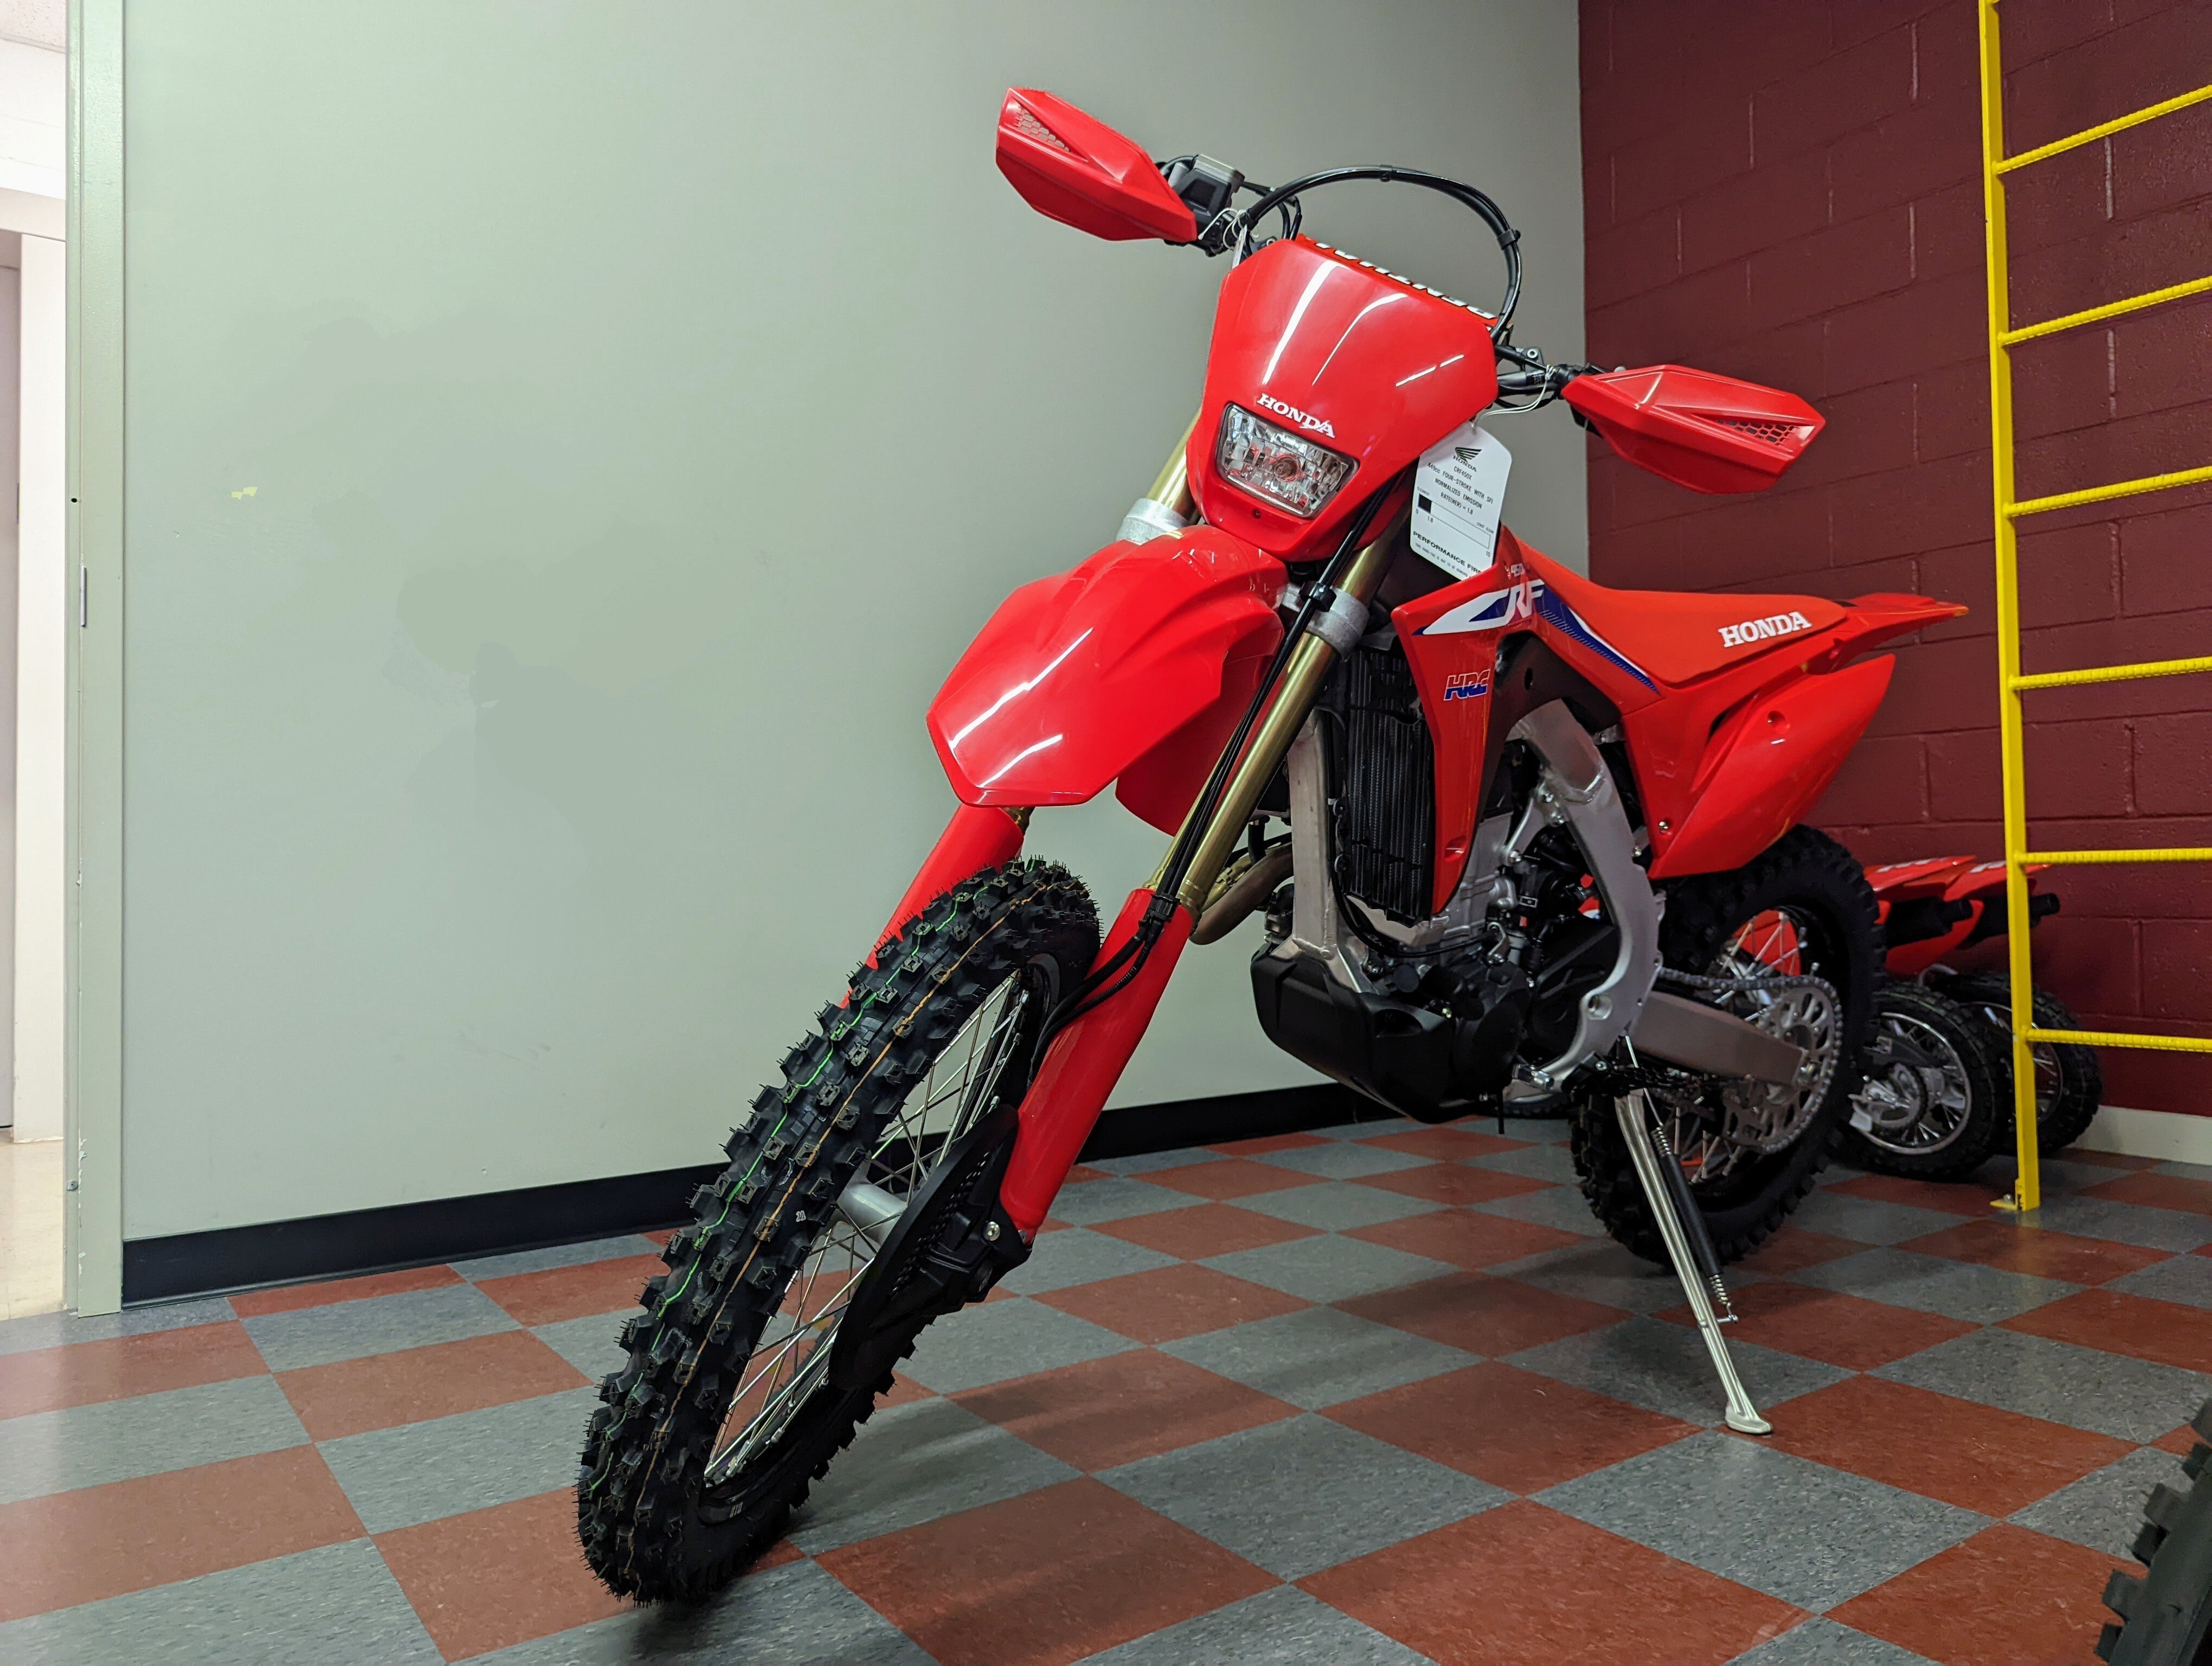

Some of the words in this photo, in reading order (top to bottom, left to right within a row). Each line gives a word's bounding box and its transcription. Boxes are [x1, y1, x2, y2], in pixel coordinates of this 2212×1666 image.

[1257, 393, 1335, 439] HONDA
[1427, 462, 1440, 474] 449cc
[1442, 471, 1472, 492] FOUR-STROKE
[1474, 489, 1484, 499] WITH
[1452, 455, 1477, 472] HONDA
[1454, 466, 1474, 480] CRF450X
[1435, 478, 1461, 496] NORMALIZED
[1463, 494, 1482, 509] EMISSION
[1413, 531, 1465, 566] PERFORMANCE
[1718, 610, 1812, 648] HONDA
[1443, 668, 1491, 701] HRC
